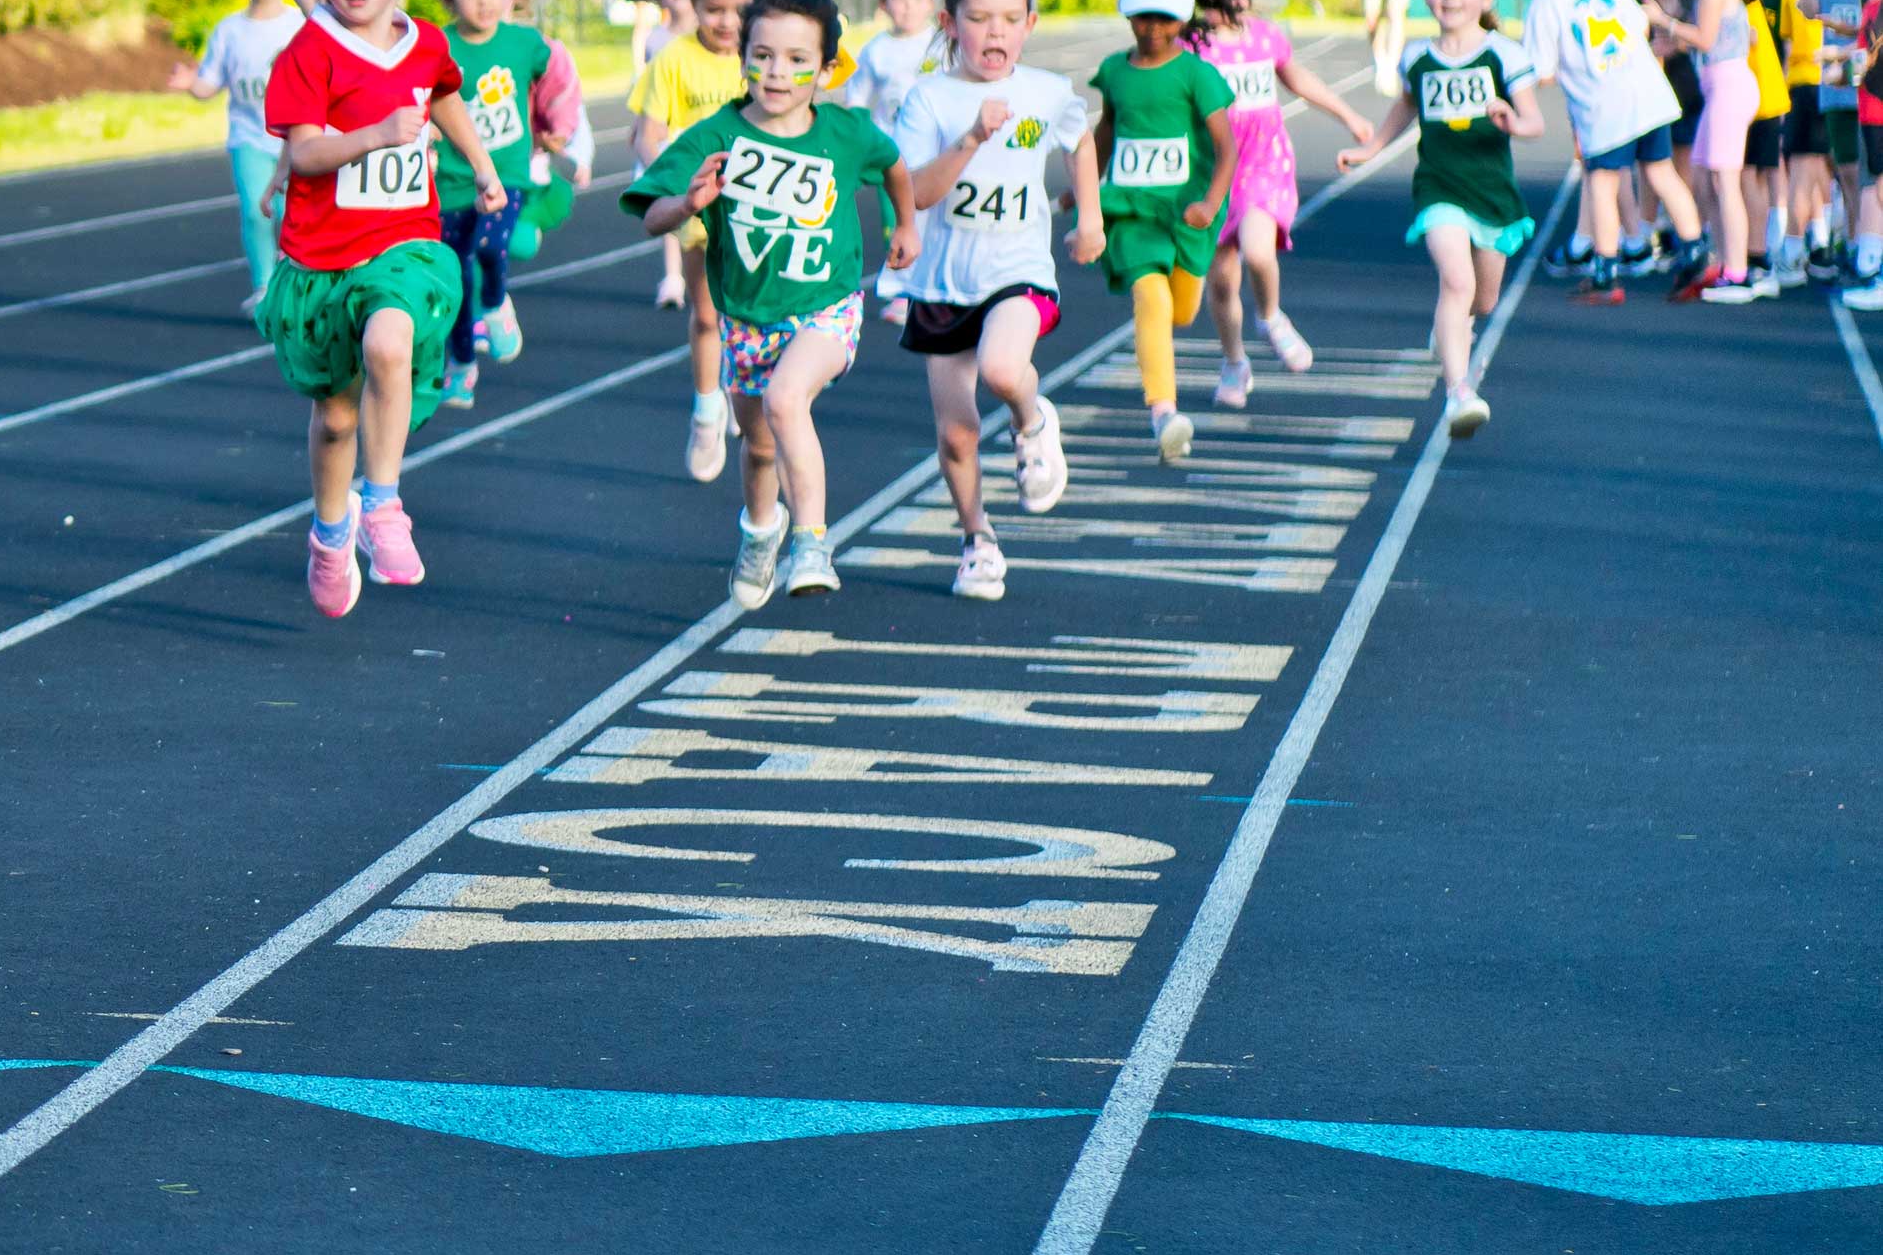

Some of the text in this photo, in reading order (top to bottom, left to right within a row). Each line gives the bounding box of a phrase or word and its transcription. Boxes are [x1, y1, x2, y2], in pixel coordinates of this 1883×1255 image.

[1426, 76, 1488, 109] 268
[474, 106, 515, 139] 32
[349, 150, 424, 194] 102
[731, 147, 822, 204] 275
[1119, 145, 1183, 175] 079
[952, 180, 1029, 221] 241
[728, 224, 833, 282] VE
[337, 627, 1294, 976] TRACK
